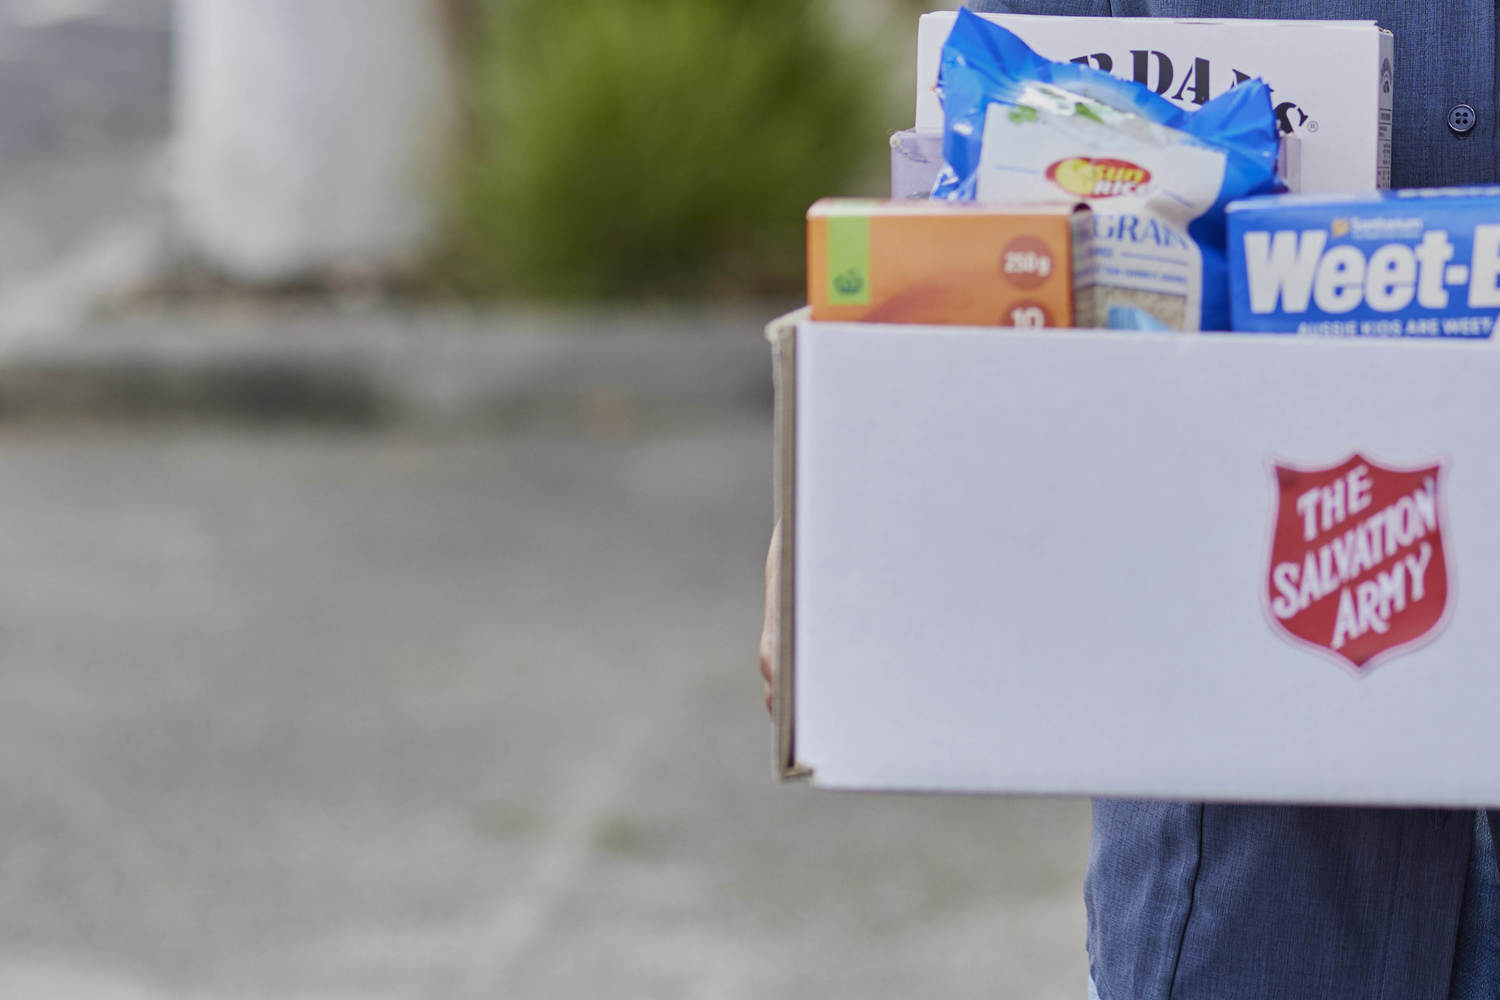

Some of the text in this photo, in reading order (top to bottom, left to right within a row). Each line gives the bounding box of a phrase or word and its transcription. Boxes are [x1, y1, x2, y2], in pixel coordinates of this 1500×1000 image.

[1010, 306, 1045, 328] 10
[1297, 319, 1357, 335] AUSSIE
[1360, 318, 1401, 335] KIDS
[1405, 317, 1439, 335] ARE
[1296, 463, 1373, 542] THE
[1272, 475, 1436, 619] SALVATION
[1330, 541, 1432, 650] ARMY
